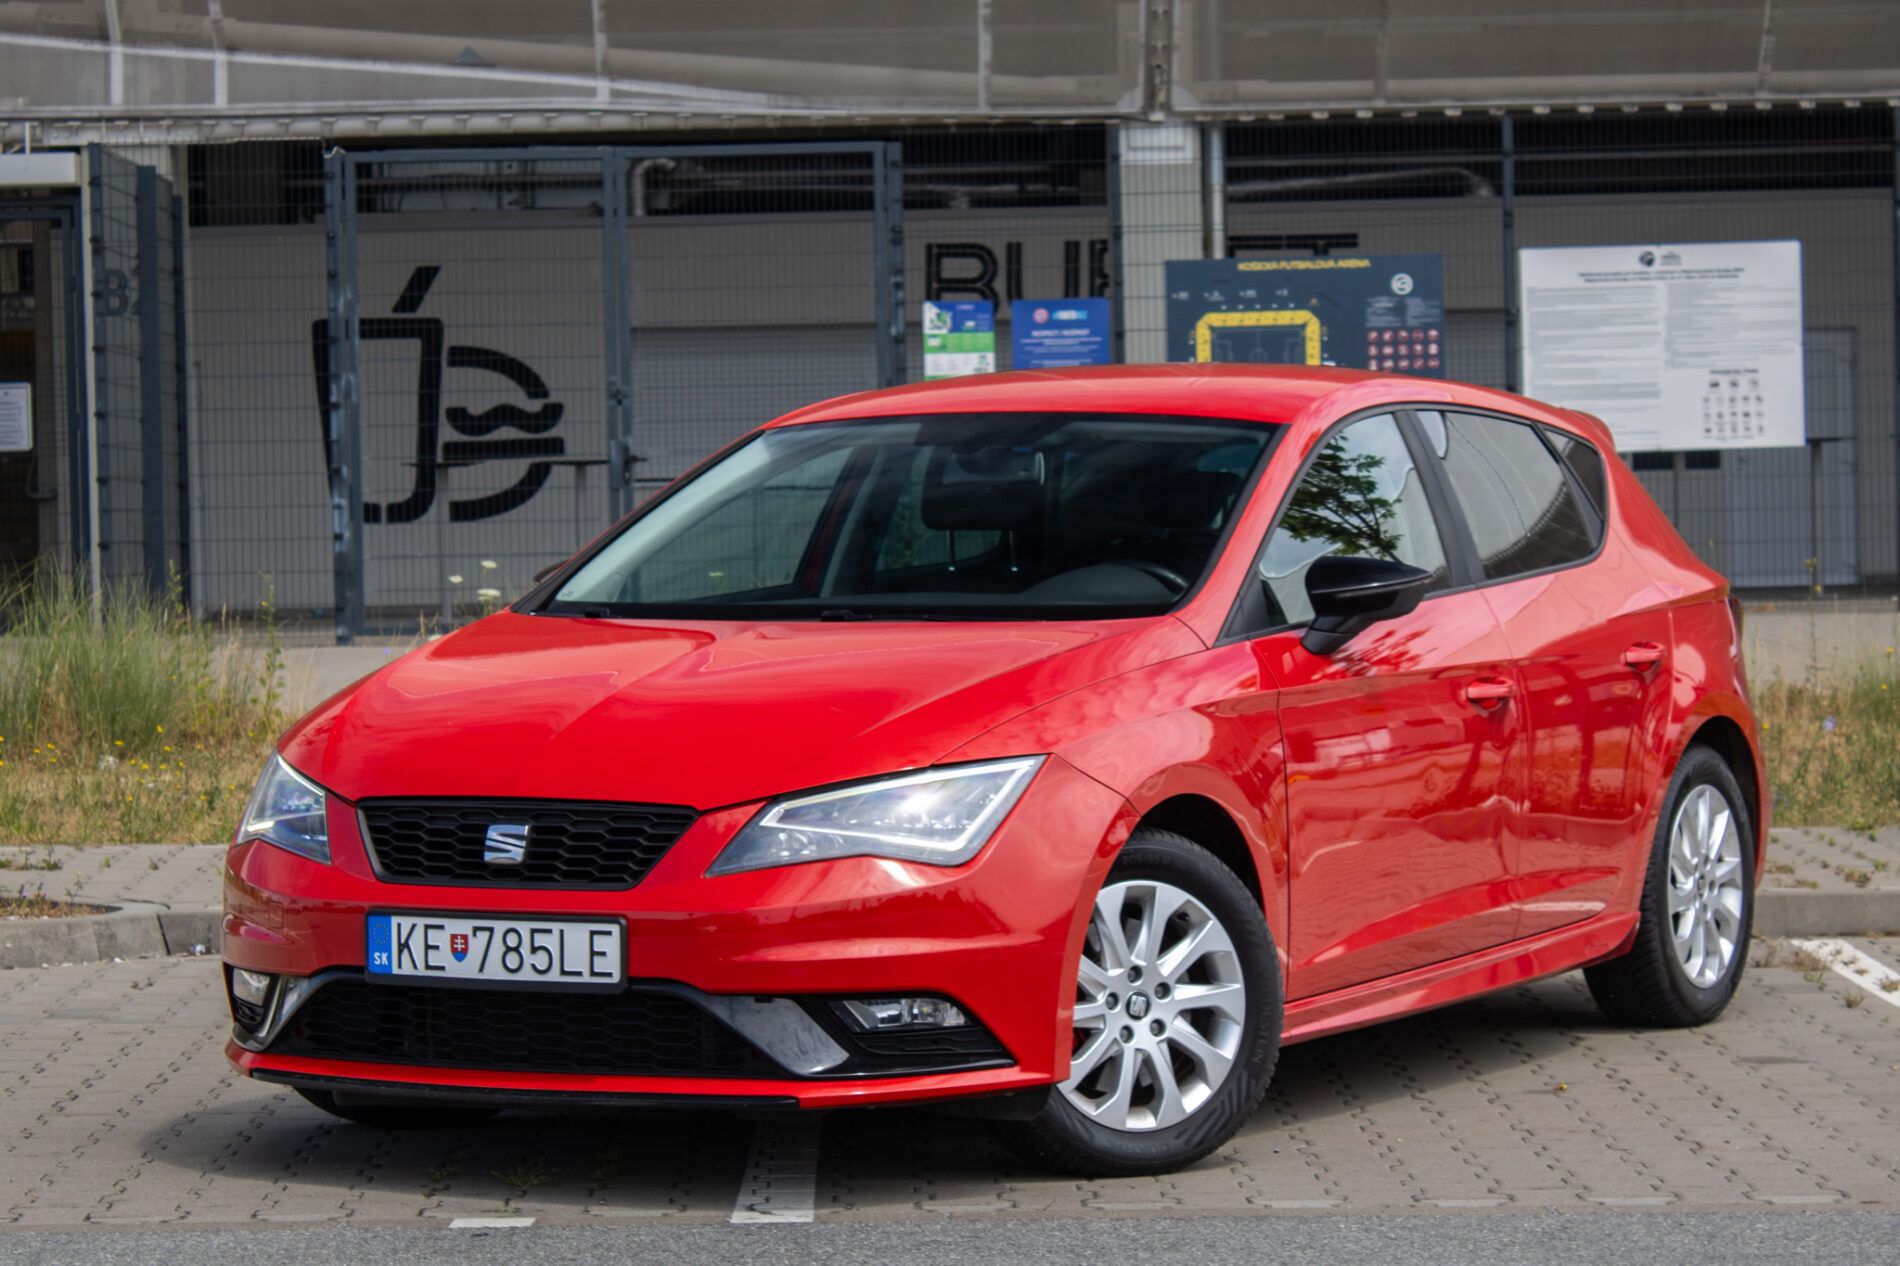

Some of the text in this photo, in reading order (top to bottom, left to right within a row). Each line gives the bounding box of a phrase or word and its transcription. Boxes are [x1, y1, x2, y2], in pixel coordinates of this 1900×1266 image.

[373, 951, 389, 966] SK
[397, 922, 614, 977] KE 785LE
